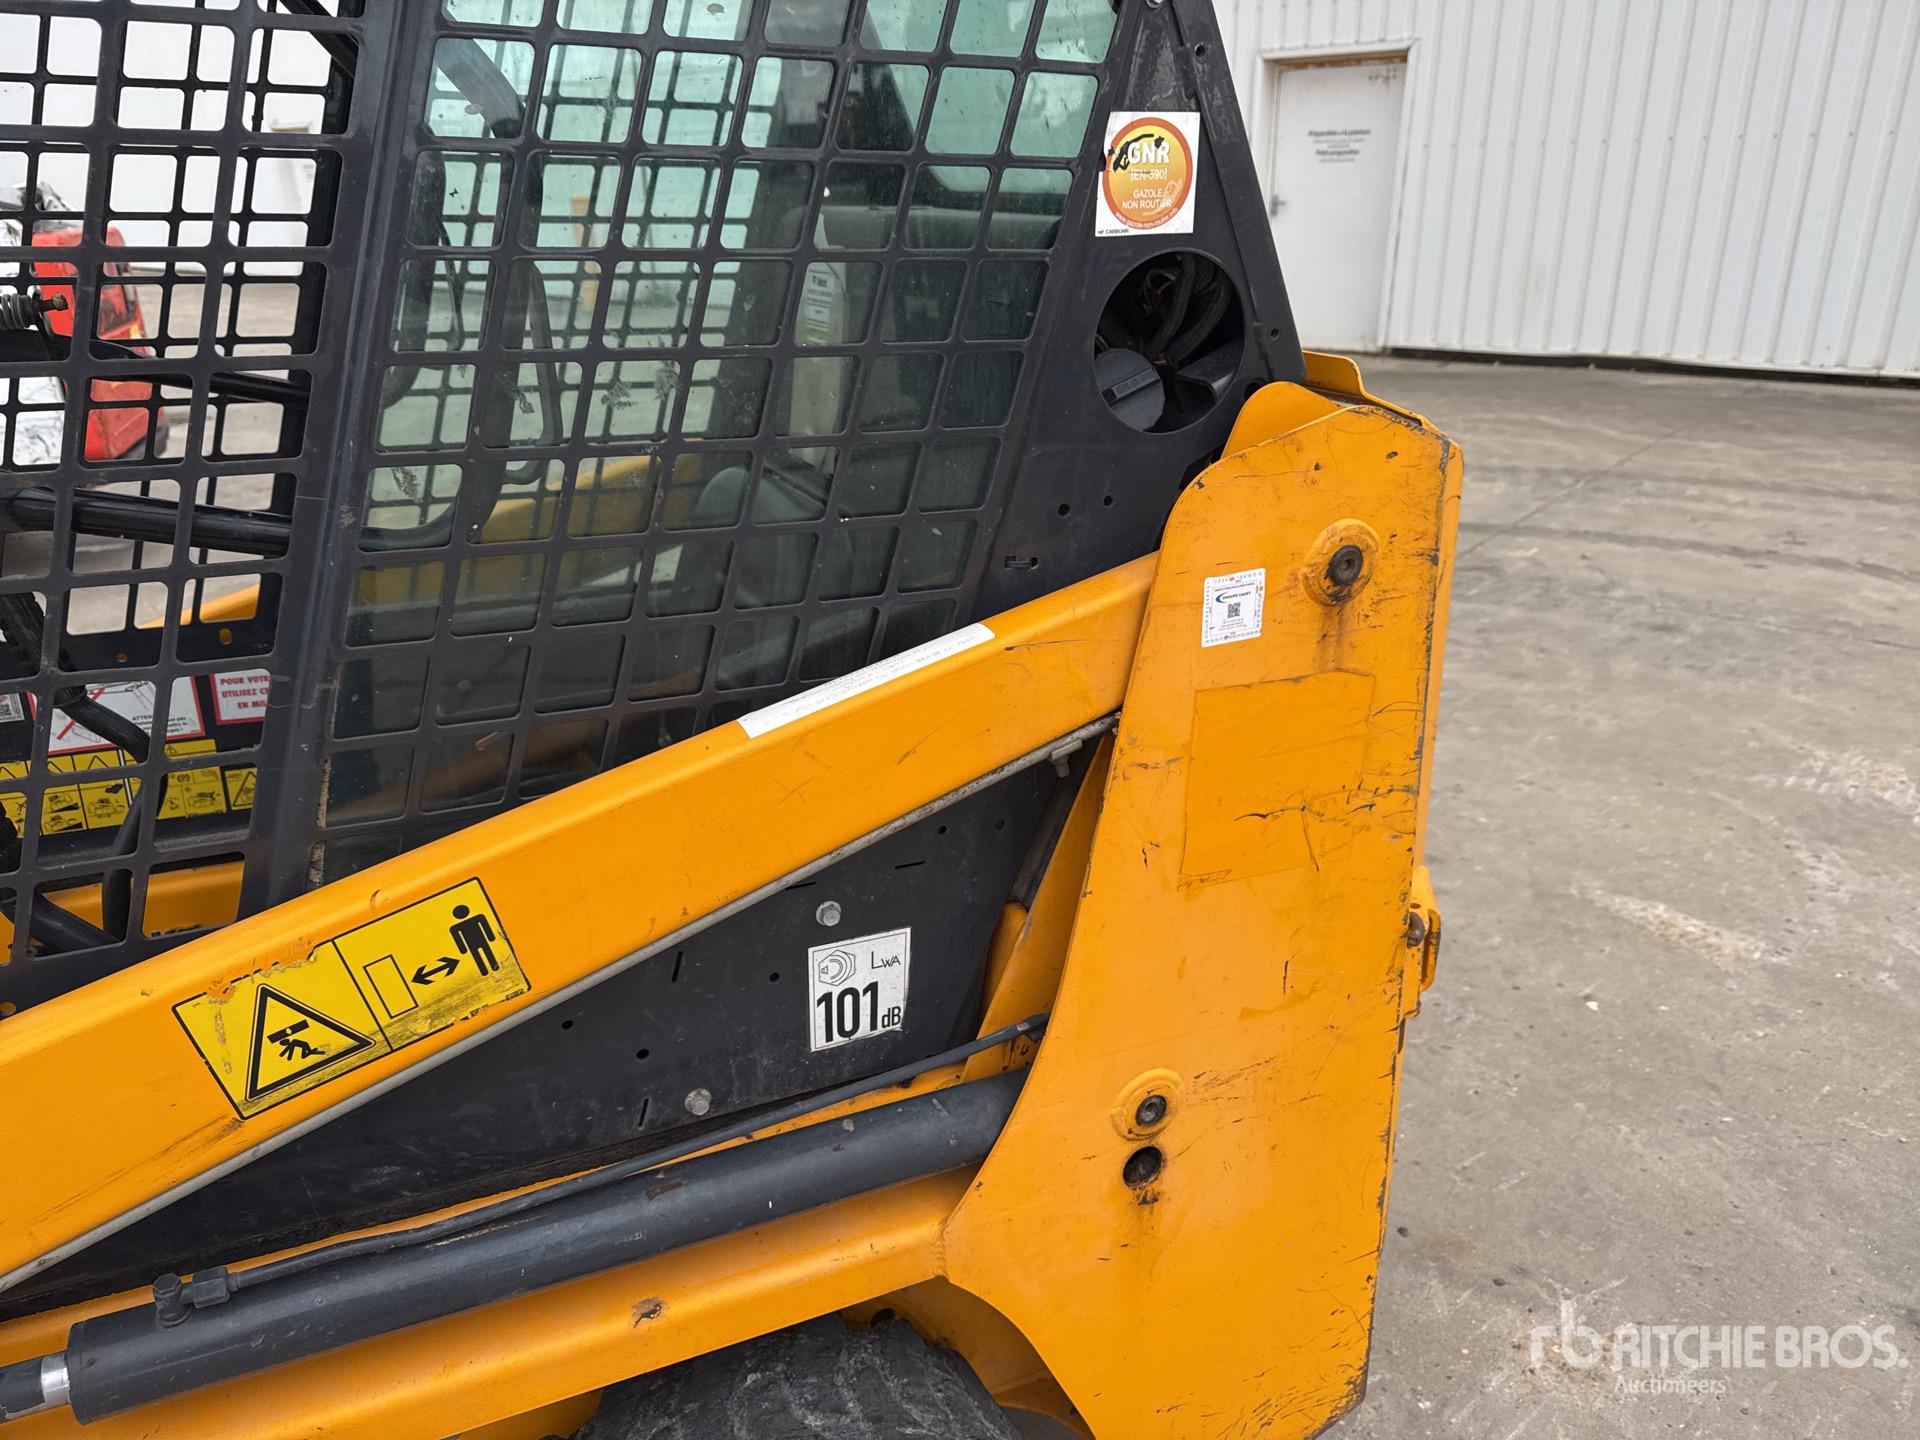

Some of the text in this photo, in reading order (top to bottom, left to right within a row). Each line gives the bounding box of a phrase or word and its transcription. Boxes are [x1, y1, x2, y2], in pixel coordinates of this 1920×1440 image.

[1128, 142, 1171, 164] GNR
[1133, 188, 1163, 199] GAZOLE
[1122, 199, 1172, 210] NON ROUTIER
[220, 675, 269, 685] POUR VOTR
[222, 688, 257, 698] UTILISEZ
[237, 701, 248, 709] EN
[817, 981, 902, 1043] 101 dB
